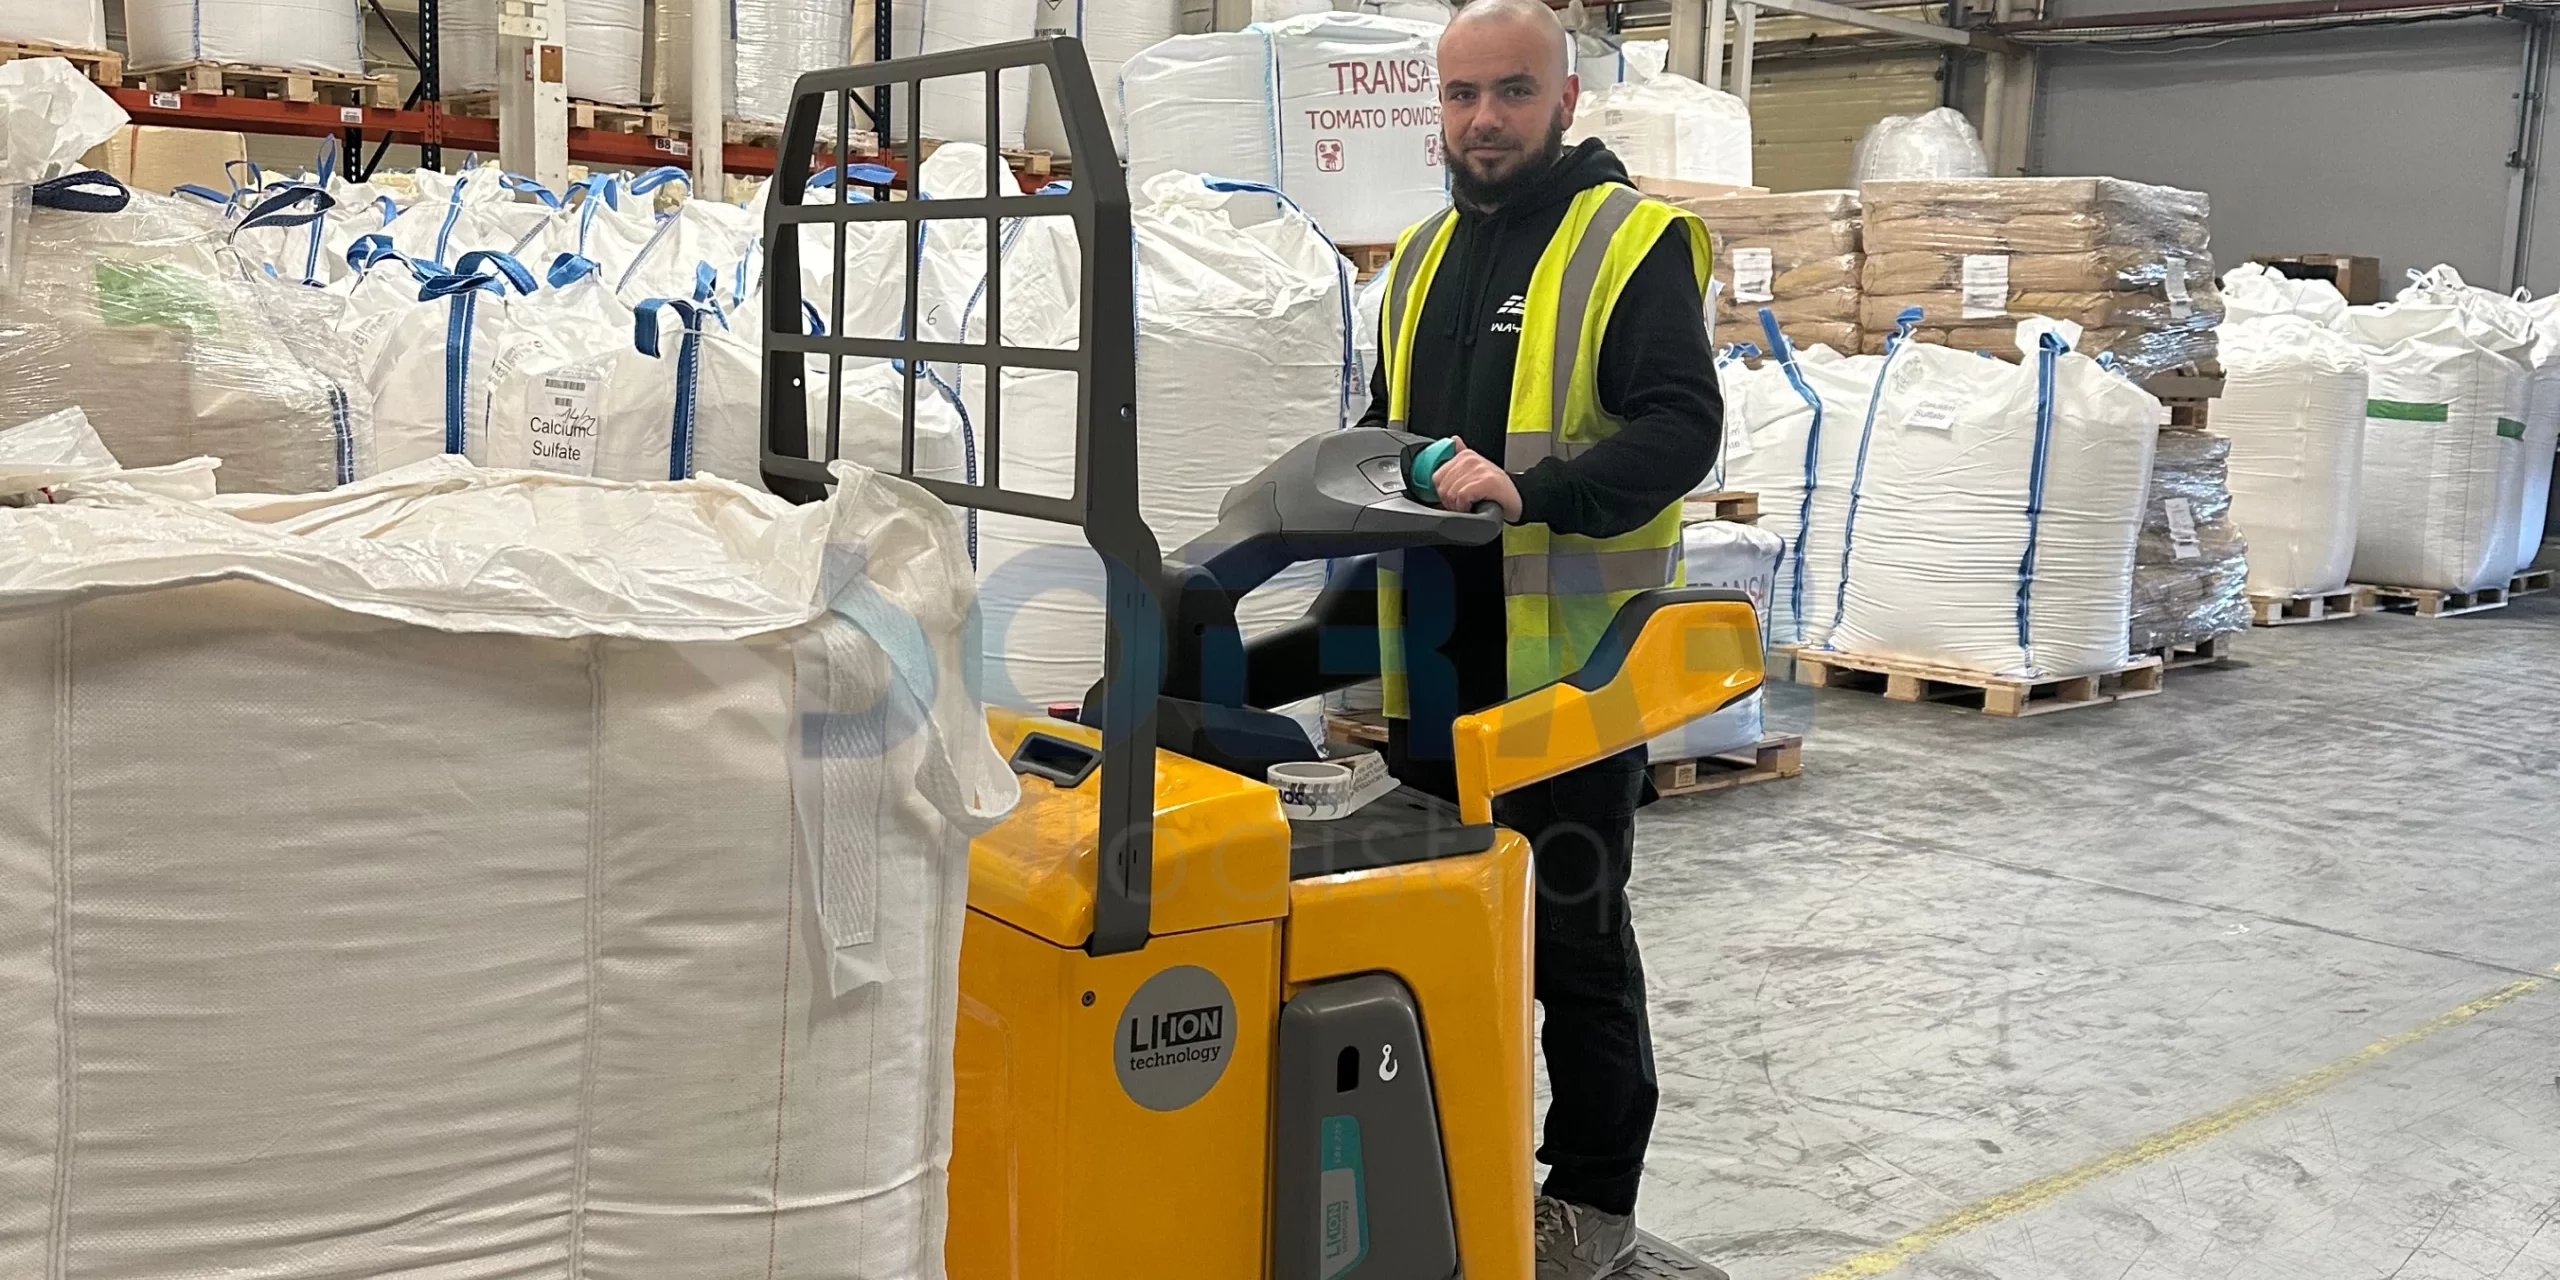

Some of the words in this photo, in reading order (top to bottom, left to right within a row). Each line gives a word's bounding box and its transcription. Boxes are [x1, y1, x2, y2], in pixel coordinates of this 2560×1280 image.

[1328, 59, 1433, 95] TRANSA
[1305, 109, 1386, 130] TOMATO
[1391, 106, 1444, 128] POWDE
[657, 138, 671, 150] B8
[530, 416, 587, 438] Calcium
[532, 439, 581, 461] Sulfate
[1129, 1045, 1222, 1071] technology
